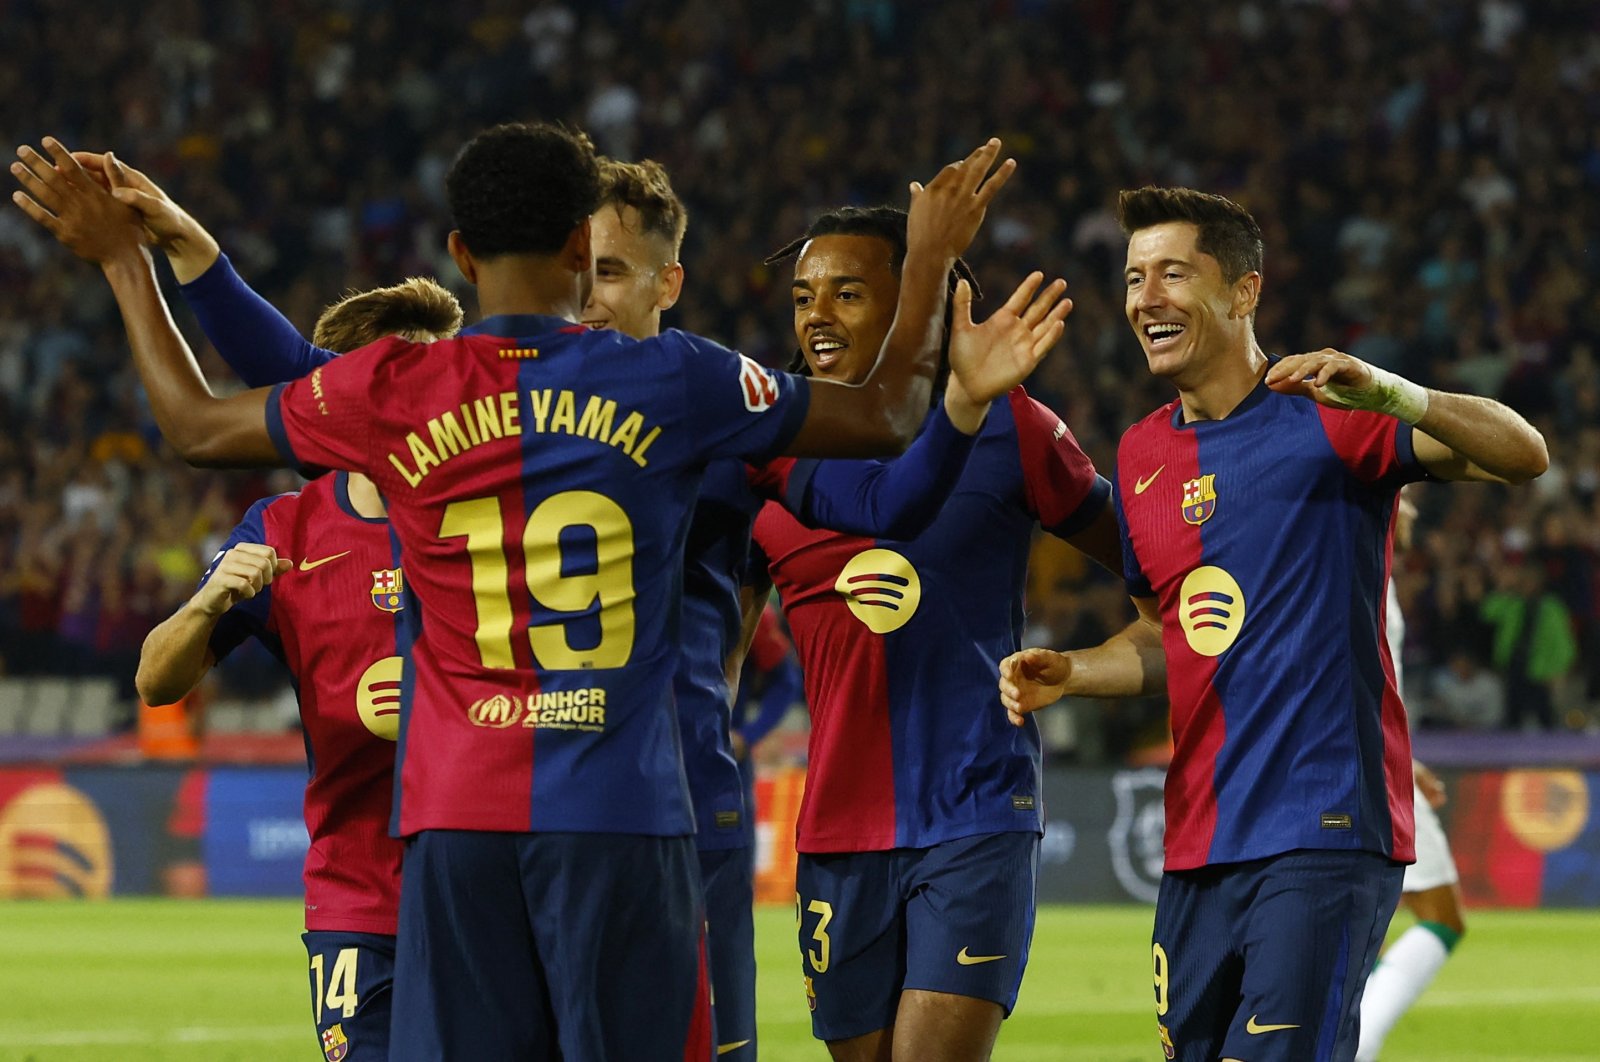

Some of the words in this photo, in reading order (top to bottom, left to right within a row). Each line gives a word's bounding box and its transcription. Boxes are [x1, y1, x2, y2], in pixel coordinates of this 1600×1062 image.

[387, 391, 523, 489] LAMINE
[529, 388, 662, 468] YAMAL
[438, 489, 636, 671] 19
[521, 705, 606, 724] ACNUR
[526, 688, 606, 711] UNHCR
[796, 891, 833, 974] 3
[310, 947, 359, 1026] 14
[1153, 942, 1169, 1016] 9
